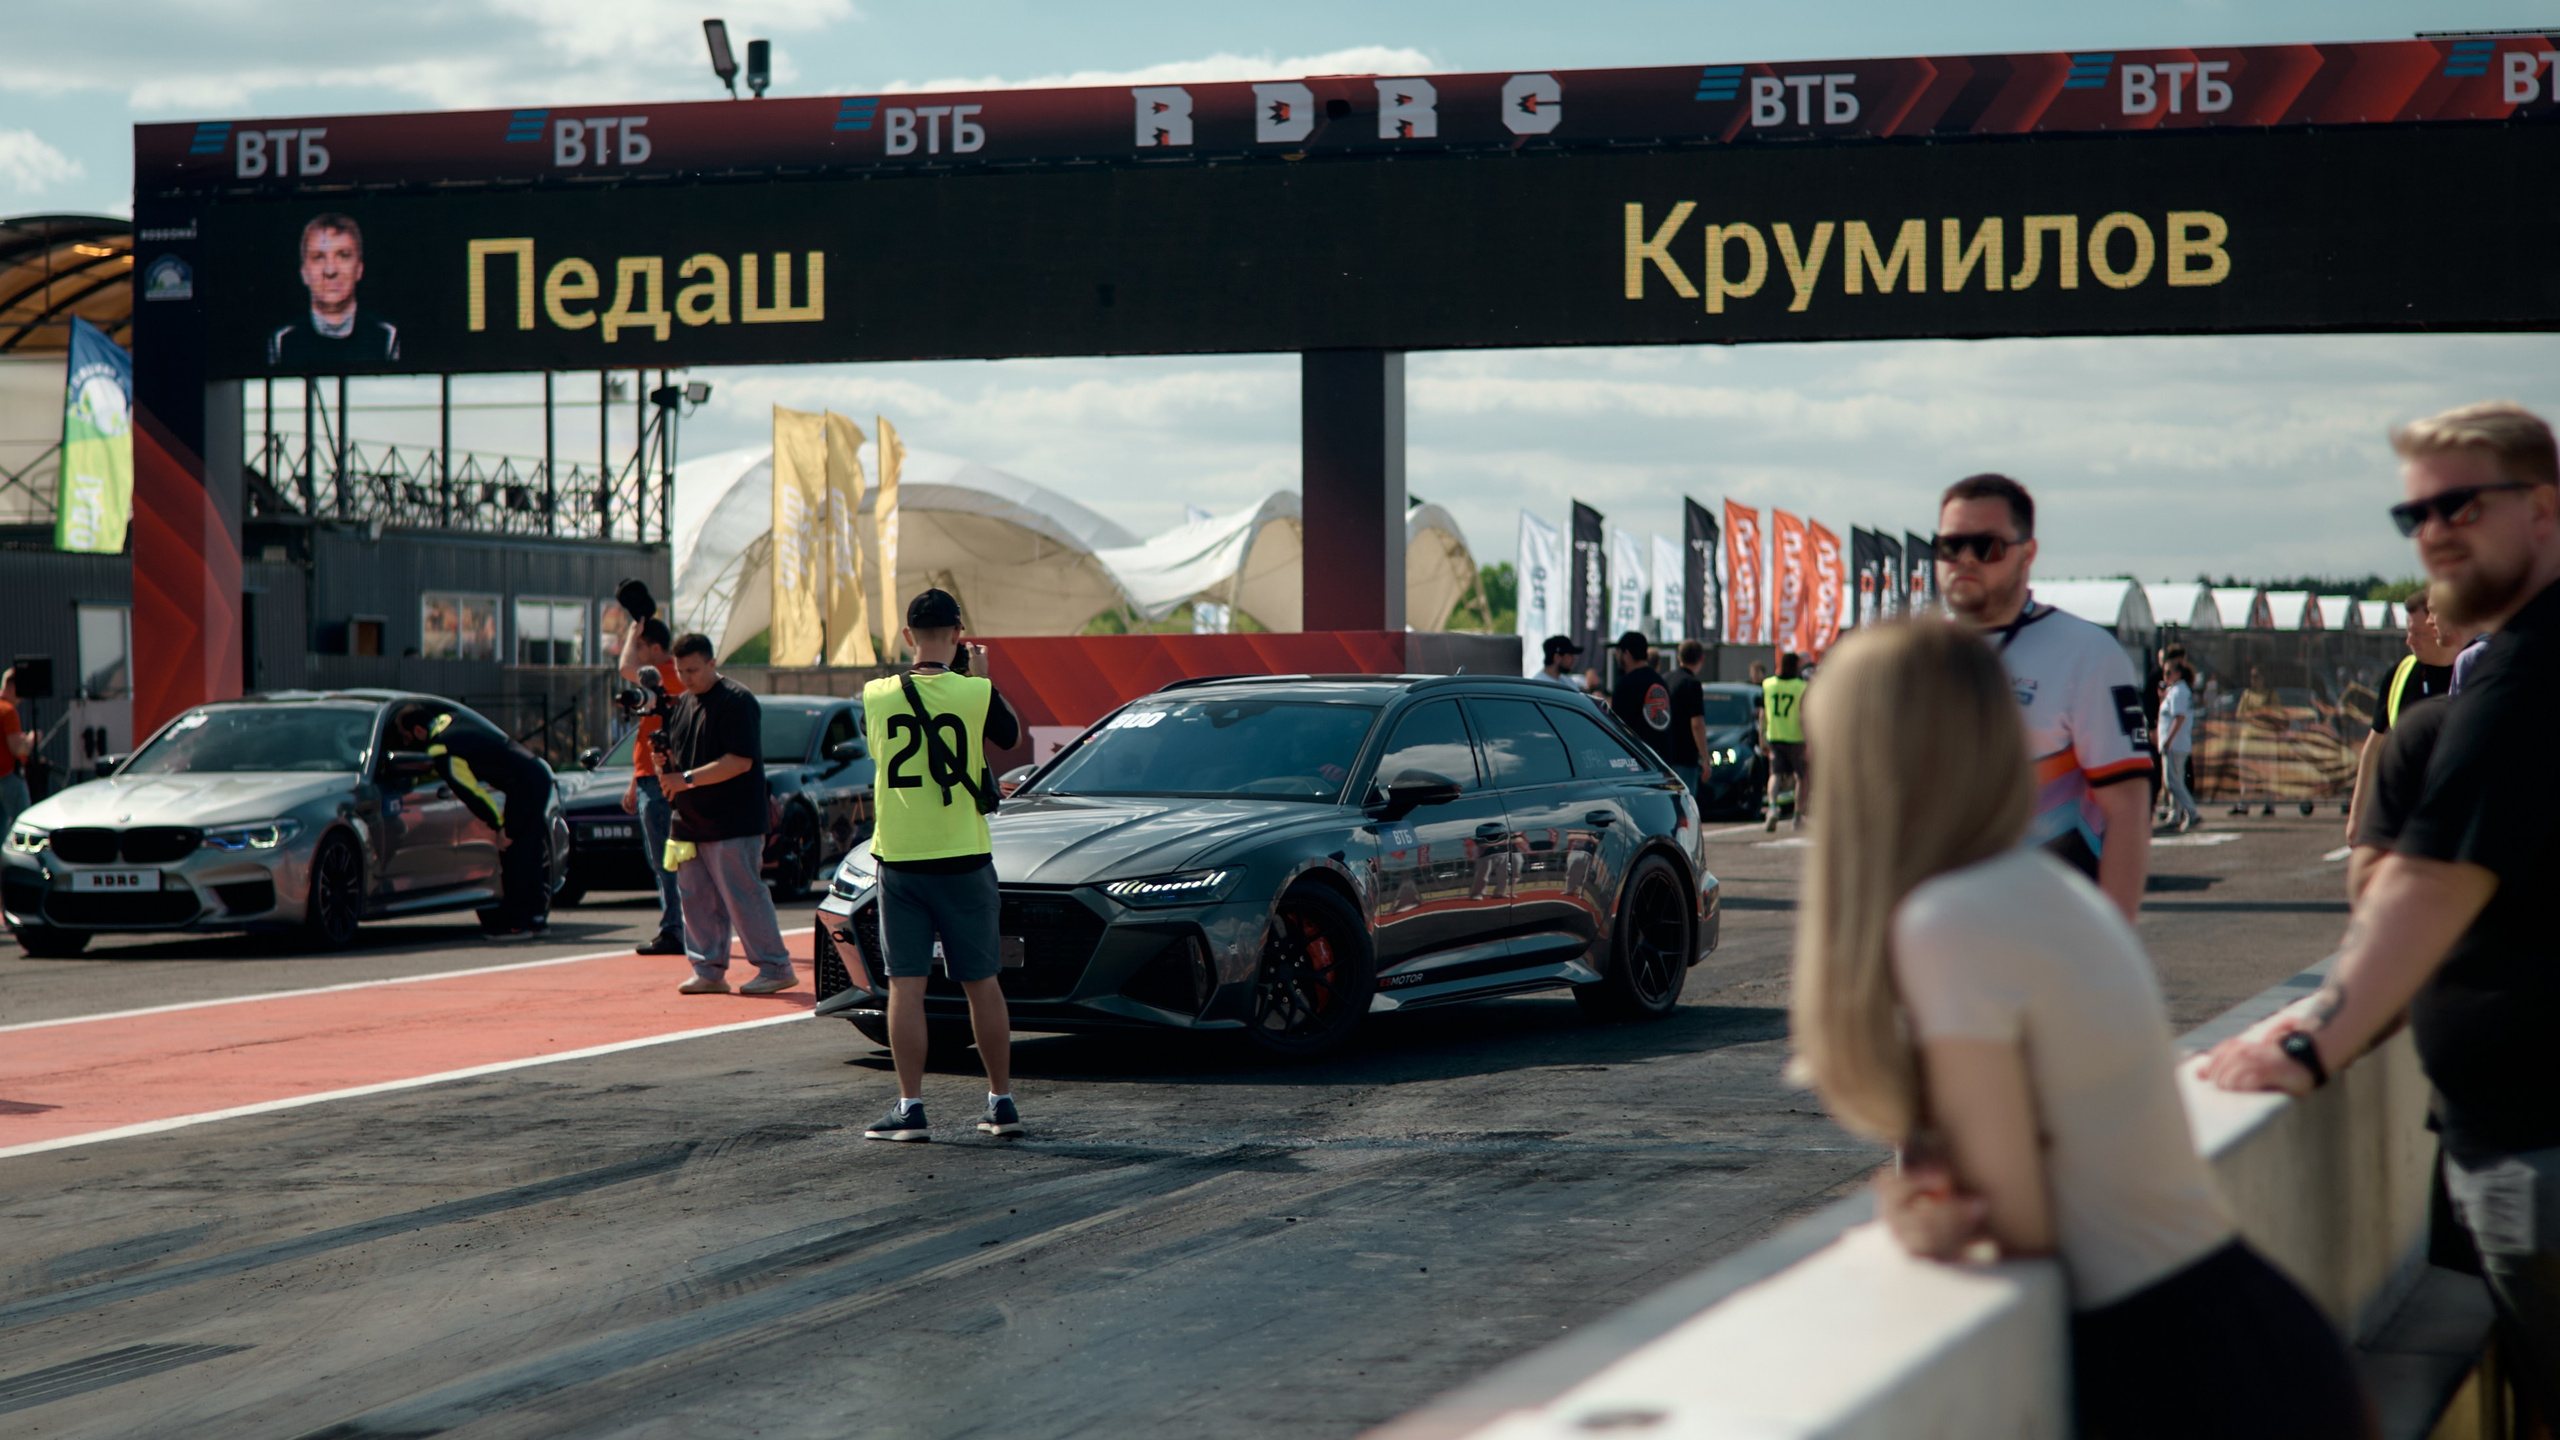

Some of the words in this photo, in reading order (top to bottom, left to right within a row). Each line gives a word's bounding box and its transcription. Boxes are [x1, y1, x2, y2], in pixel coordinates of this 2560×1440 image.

[1750, 74, 1860, 127] ВТБ
[2121, 61, 2233, 115] ВТБ
[236, 128, 330, 179] ВТБ
[554, 116, 652, 168] ВТБ
[885, 104, 986, 156] ВТБ
[1625, 201, 2232, 314] Крумилов
[468, 237, 825, 343] Педаш
[1779, 531, 1803, 652] auto.ru
[1772, 692, 1795, 718] 17
[887, 713, 968, 789] 20
[1392, 829, 1413, 845] ВТБ
